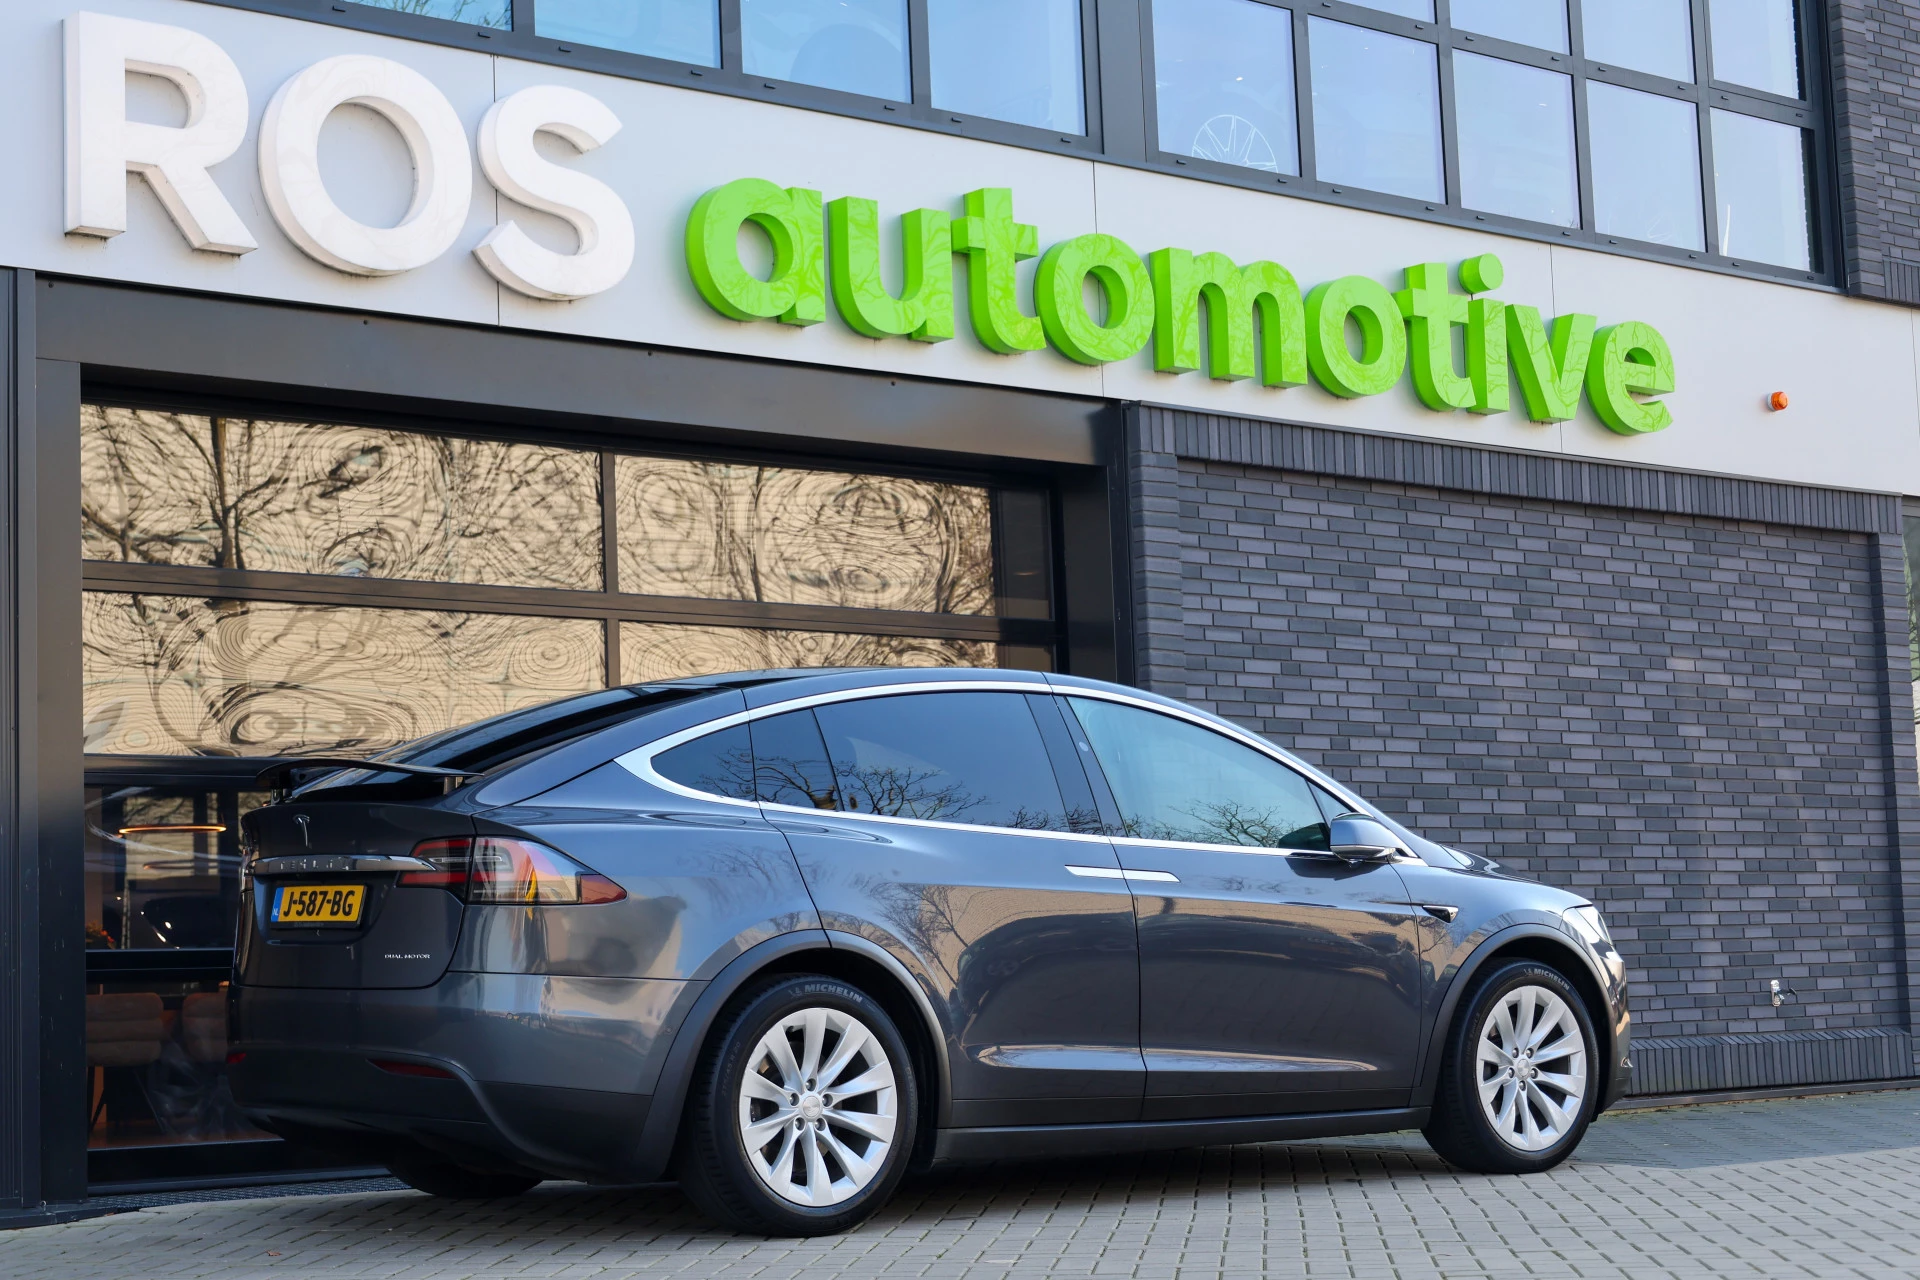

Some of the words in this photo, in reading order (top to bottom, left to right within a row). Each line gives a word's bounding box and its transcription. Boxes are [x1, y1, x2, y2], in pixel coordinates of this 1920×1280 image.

[62, 11, 635, 301] ROS
[685, 177, 1675, 436] automotive
[273, 908, 279, 916] NL
[283, 890, 355, 917] J-587-BG
[1533, 968, 1570, 991] MICHELIN
[804, 983, 863, 1003] MICHELIN
